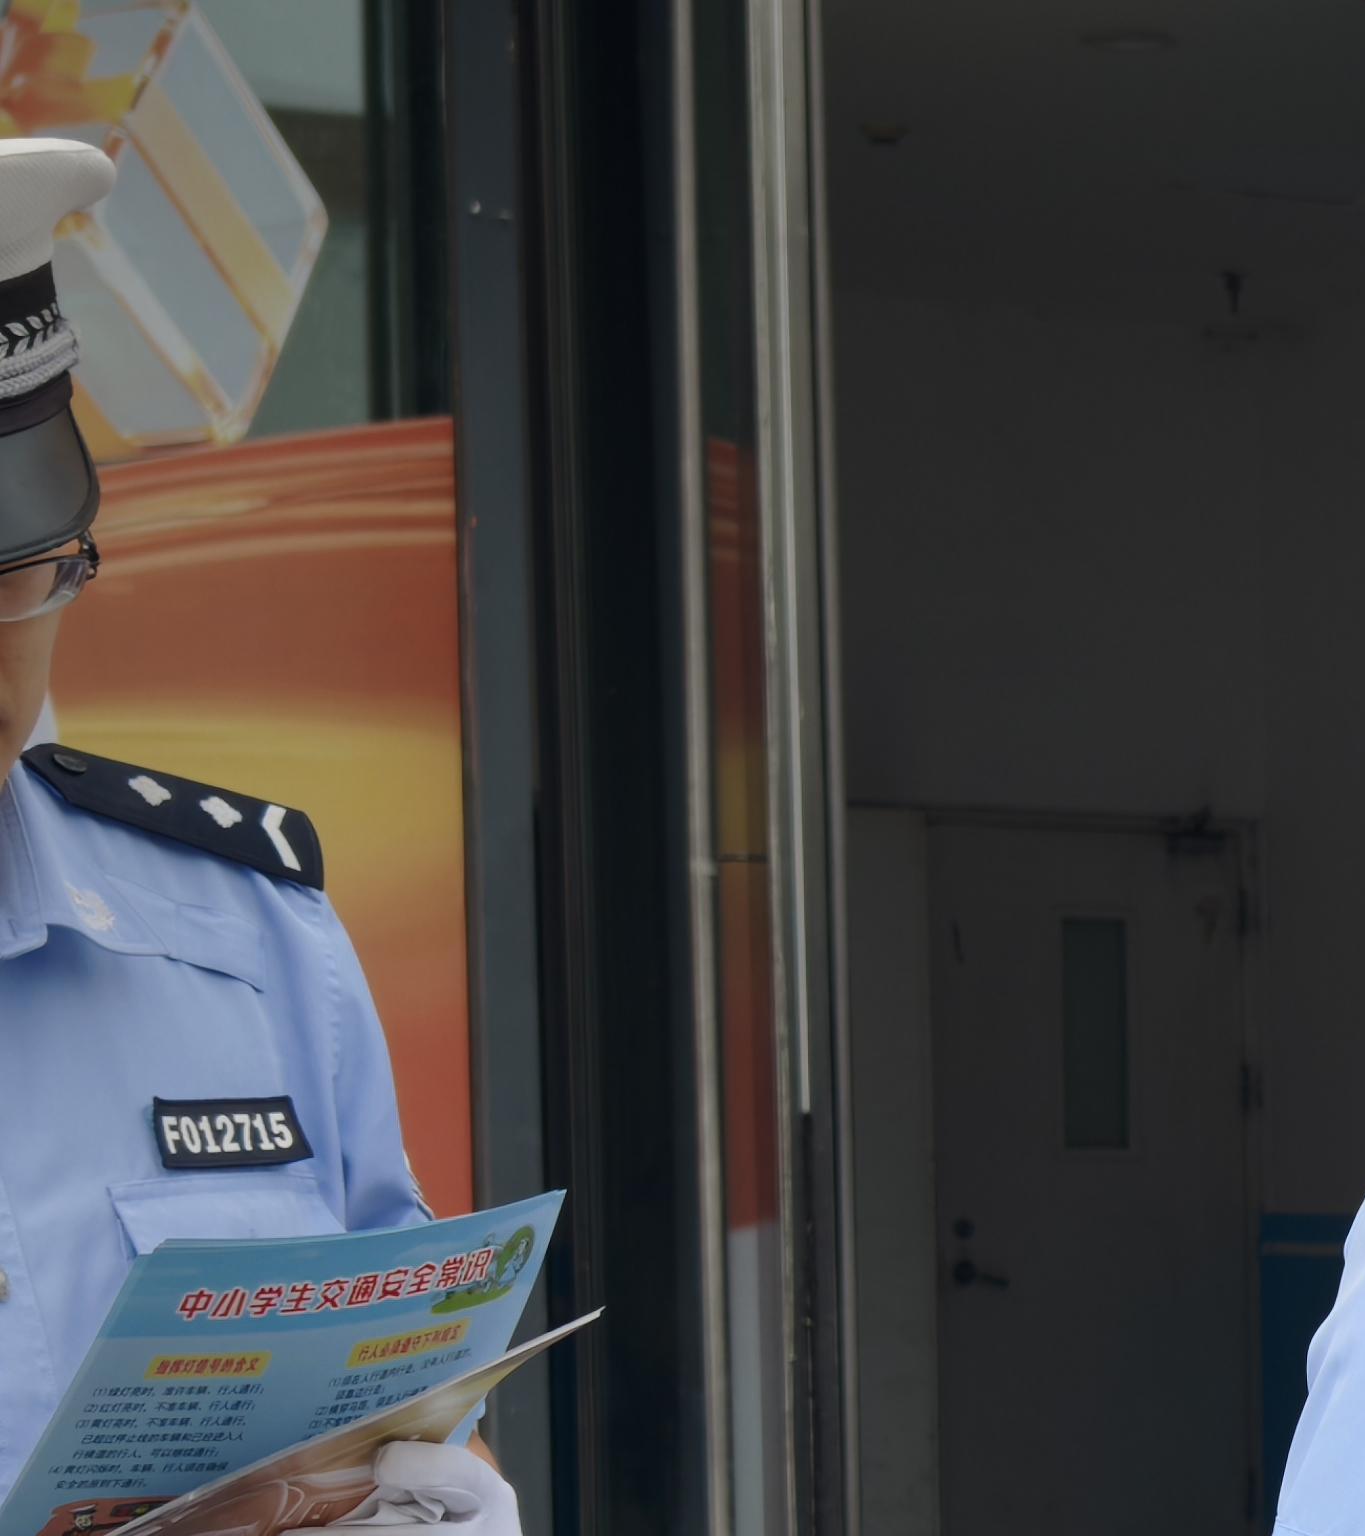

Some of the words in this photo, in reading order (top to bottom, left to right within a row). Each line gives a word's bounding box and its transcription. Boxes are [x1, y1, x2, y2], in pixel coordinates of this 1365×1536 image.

[162, 1110, 295, 1155] F012715
[178, 1248, 494, 1320] 中小学生交通安全常识
